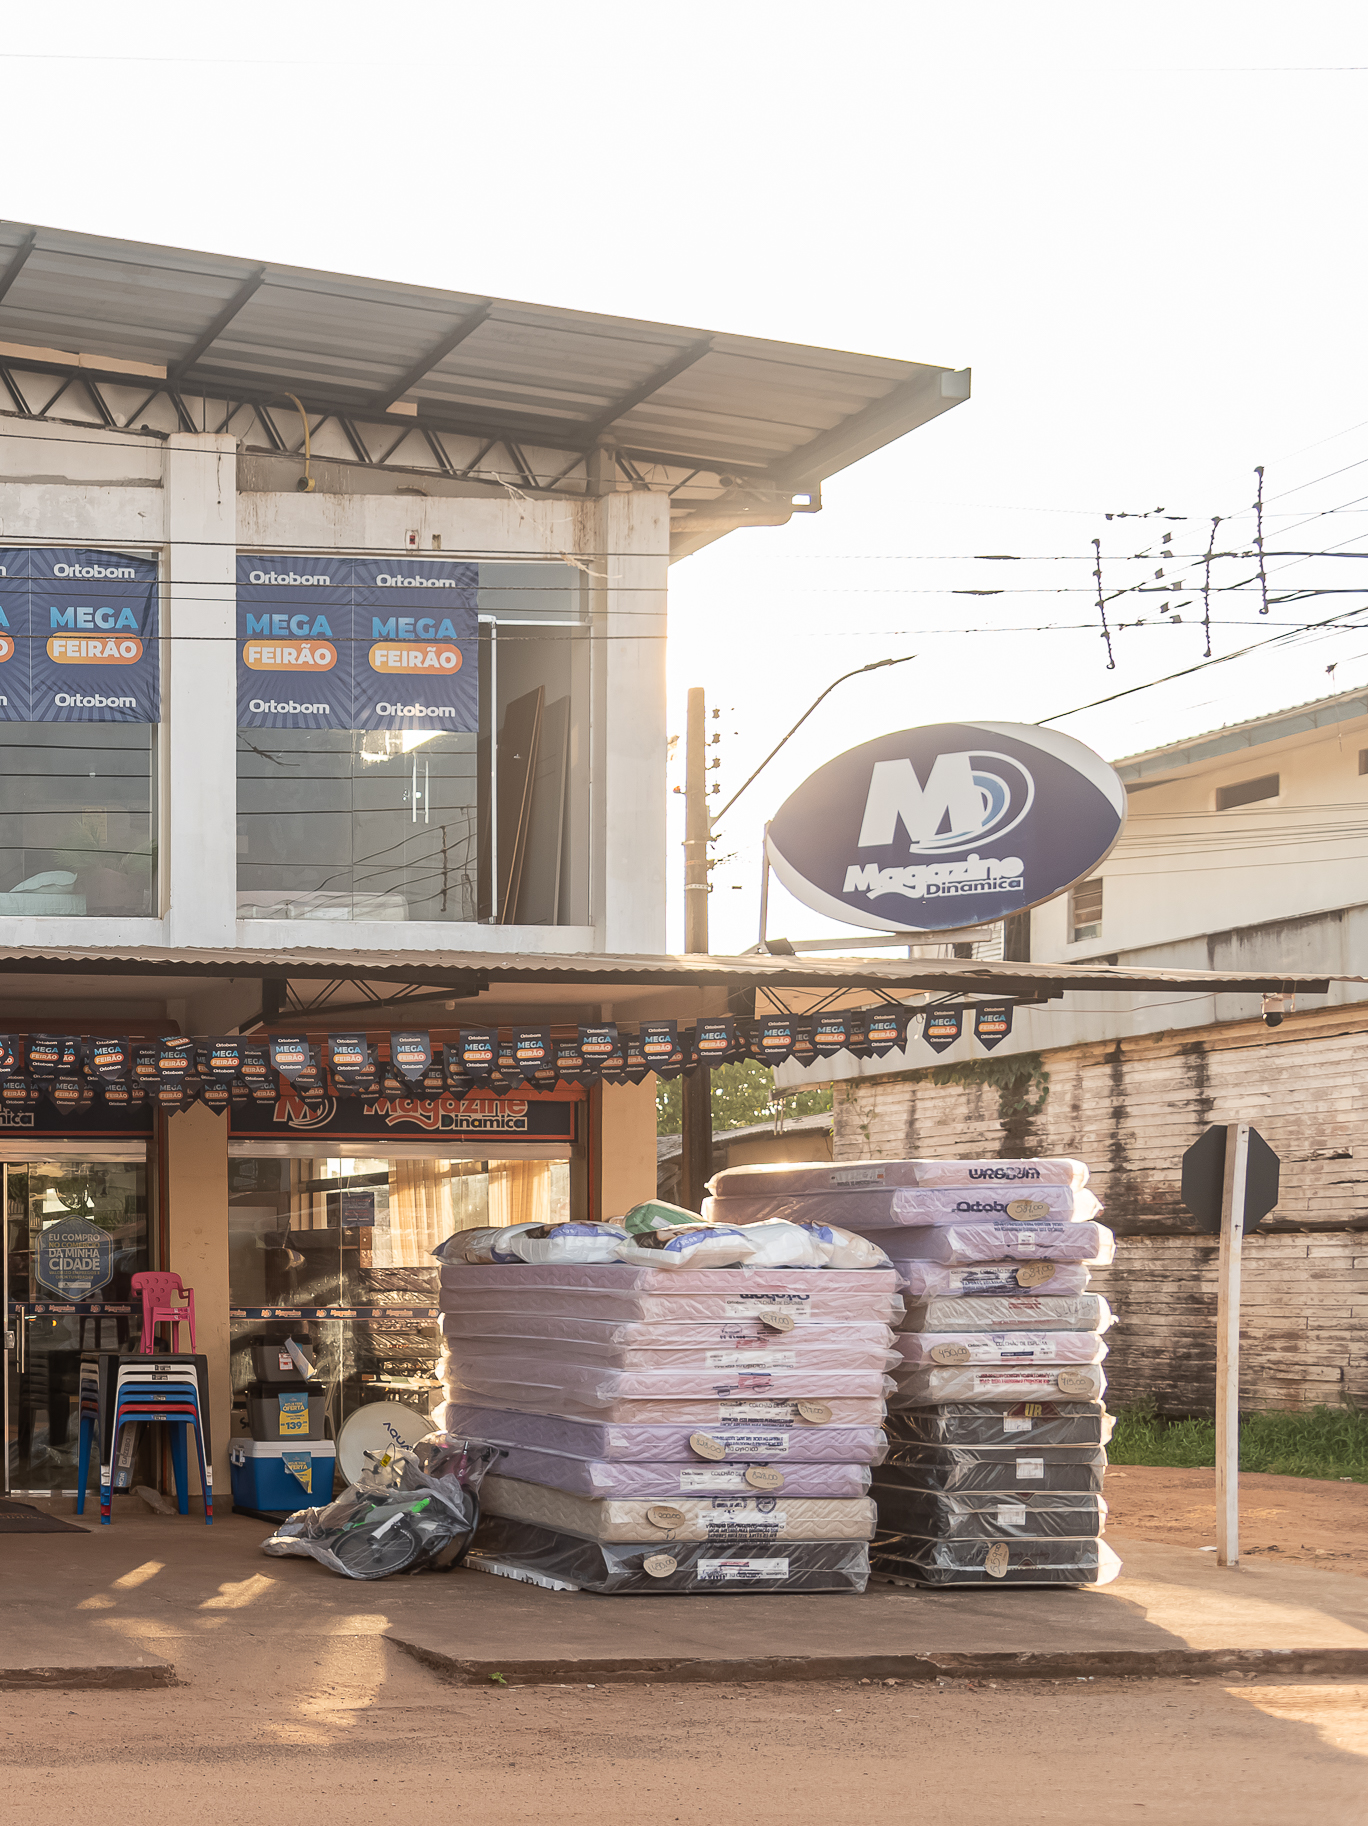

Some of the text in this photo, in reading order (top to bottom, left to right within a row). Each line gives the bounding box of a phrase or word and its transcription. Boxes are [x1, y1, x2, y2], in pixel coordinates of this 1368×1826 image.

[53, 563, 135, 579] Ortobom
[249, 570, 331, 586] Ortobom
[376, 574, 456, 588] Ortobom
[50, 606, 139, 629] MEGA
[246, 613, 332, 636] MEGA
[372, 616, 457, 639] MEGA
[53, 638, 137, 658] FEIRÃO
[248, 643, 331, 665] FEIRÃO
[374, 647, 457, 669] FEIRÃO
[54, 693, 136, 708] Ortobom
[249, 699, 330, 714] Ortobom
[375, 702, 456, 717] Ortobom
[842, 854, 1025, 900] Magazine
[926, 877, 1023, 896] Dinamica
[94, 1047, 122, 1055] MEGA
[518, 1040, 544, 1048] MEGA
[96, 1054, 122, 1064] FEIRÃO
[518, 1049, 544, 1057] FEIRÃO
[439, 1114, 527, 1130] Dinamica
[49, 1249, 100, 1258] DA MINHA
[49, 1258, 100, 1270] CIDADE
[286, 1421, 302, 1430] 139
